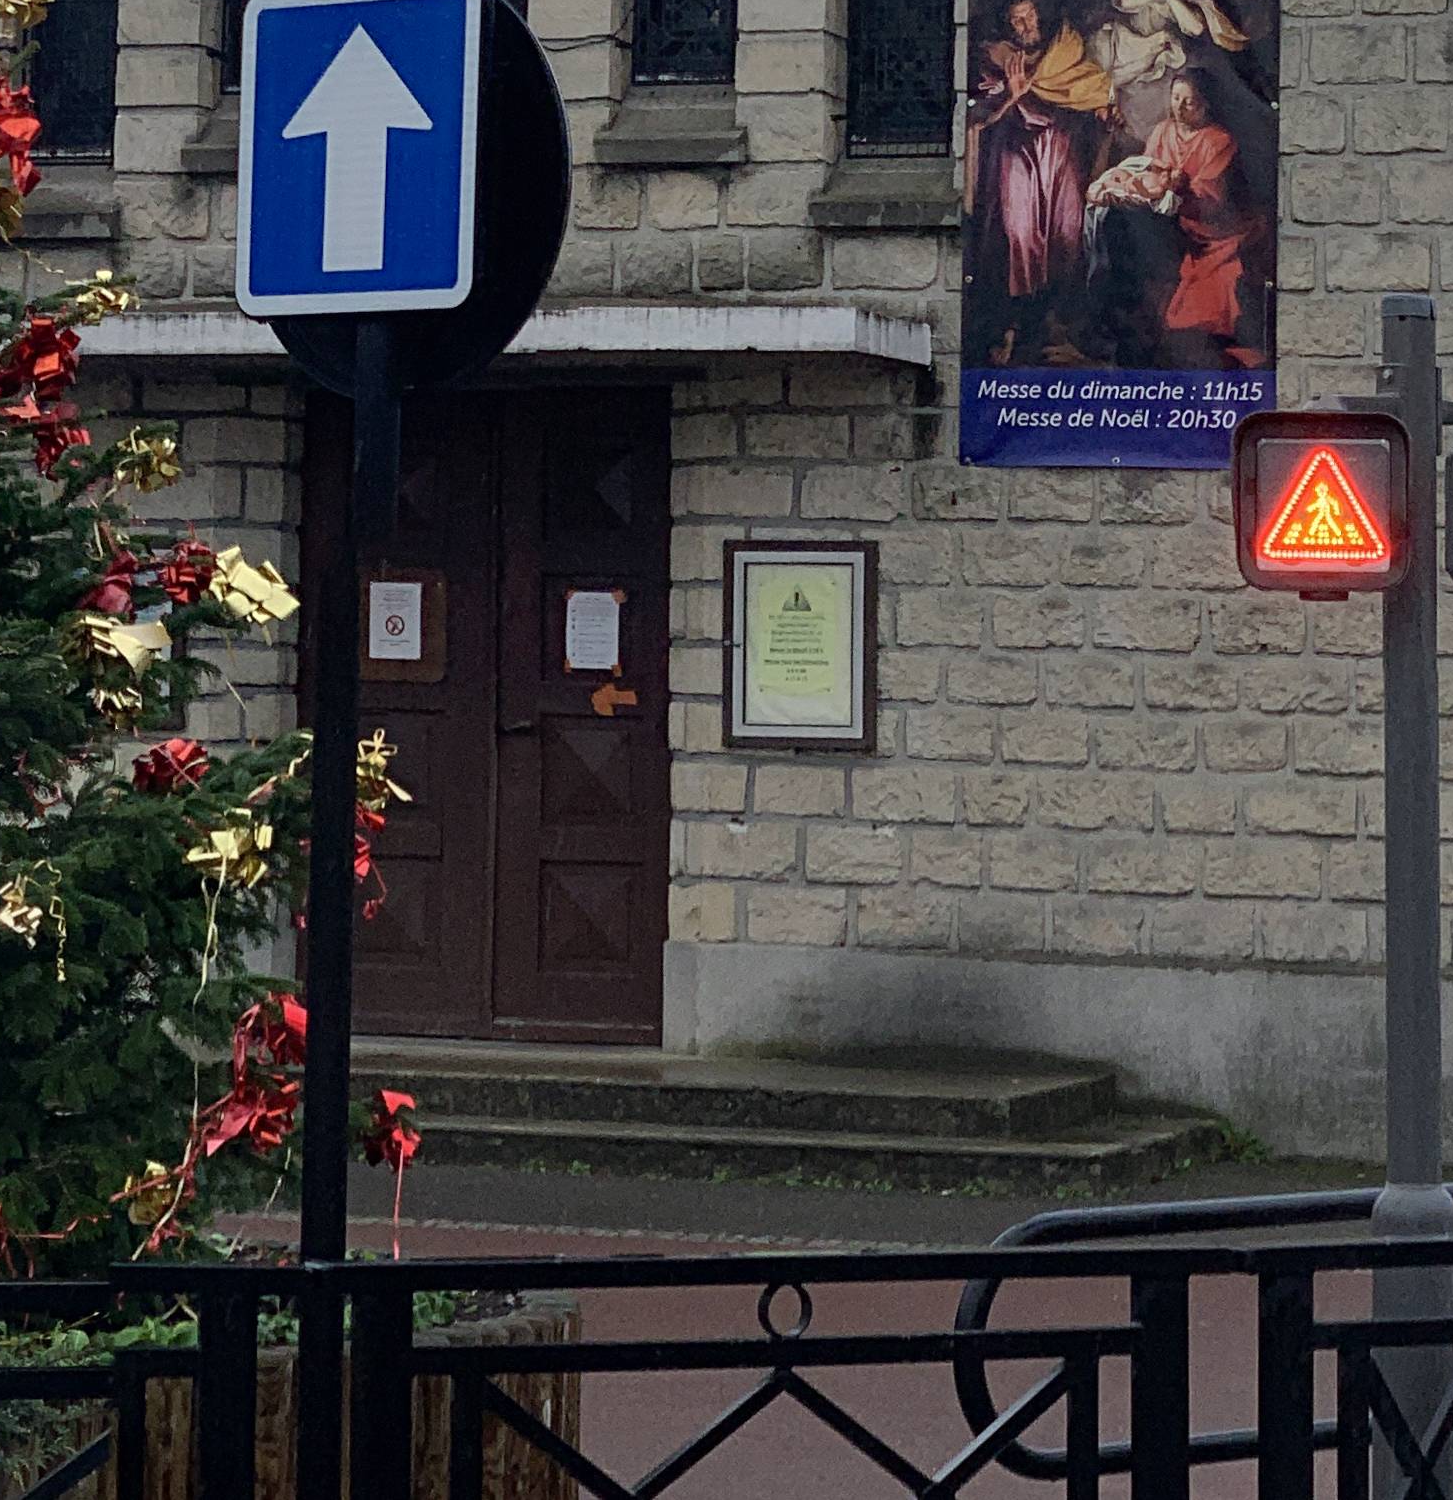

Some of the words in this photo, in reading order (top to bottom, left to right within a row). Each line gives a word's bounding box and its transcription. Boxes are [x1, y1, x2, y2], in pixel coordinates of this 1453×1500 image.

[978, 380, 1042, 400] Messe
[1047, 381, 1074, 400] du
[1080, 381, 1184, 401] dimanche
[1201, 382, 1263, 401] 11h15
[997, 408, 1063, 427] Messe
[1067, 408, 1094, 428] de
[1099, 408, 1149, 428] Noël
[1166, 409, 1237, 429] 20h30
